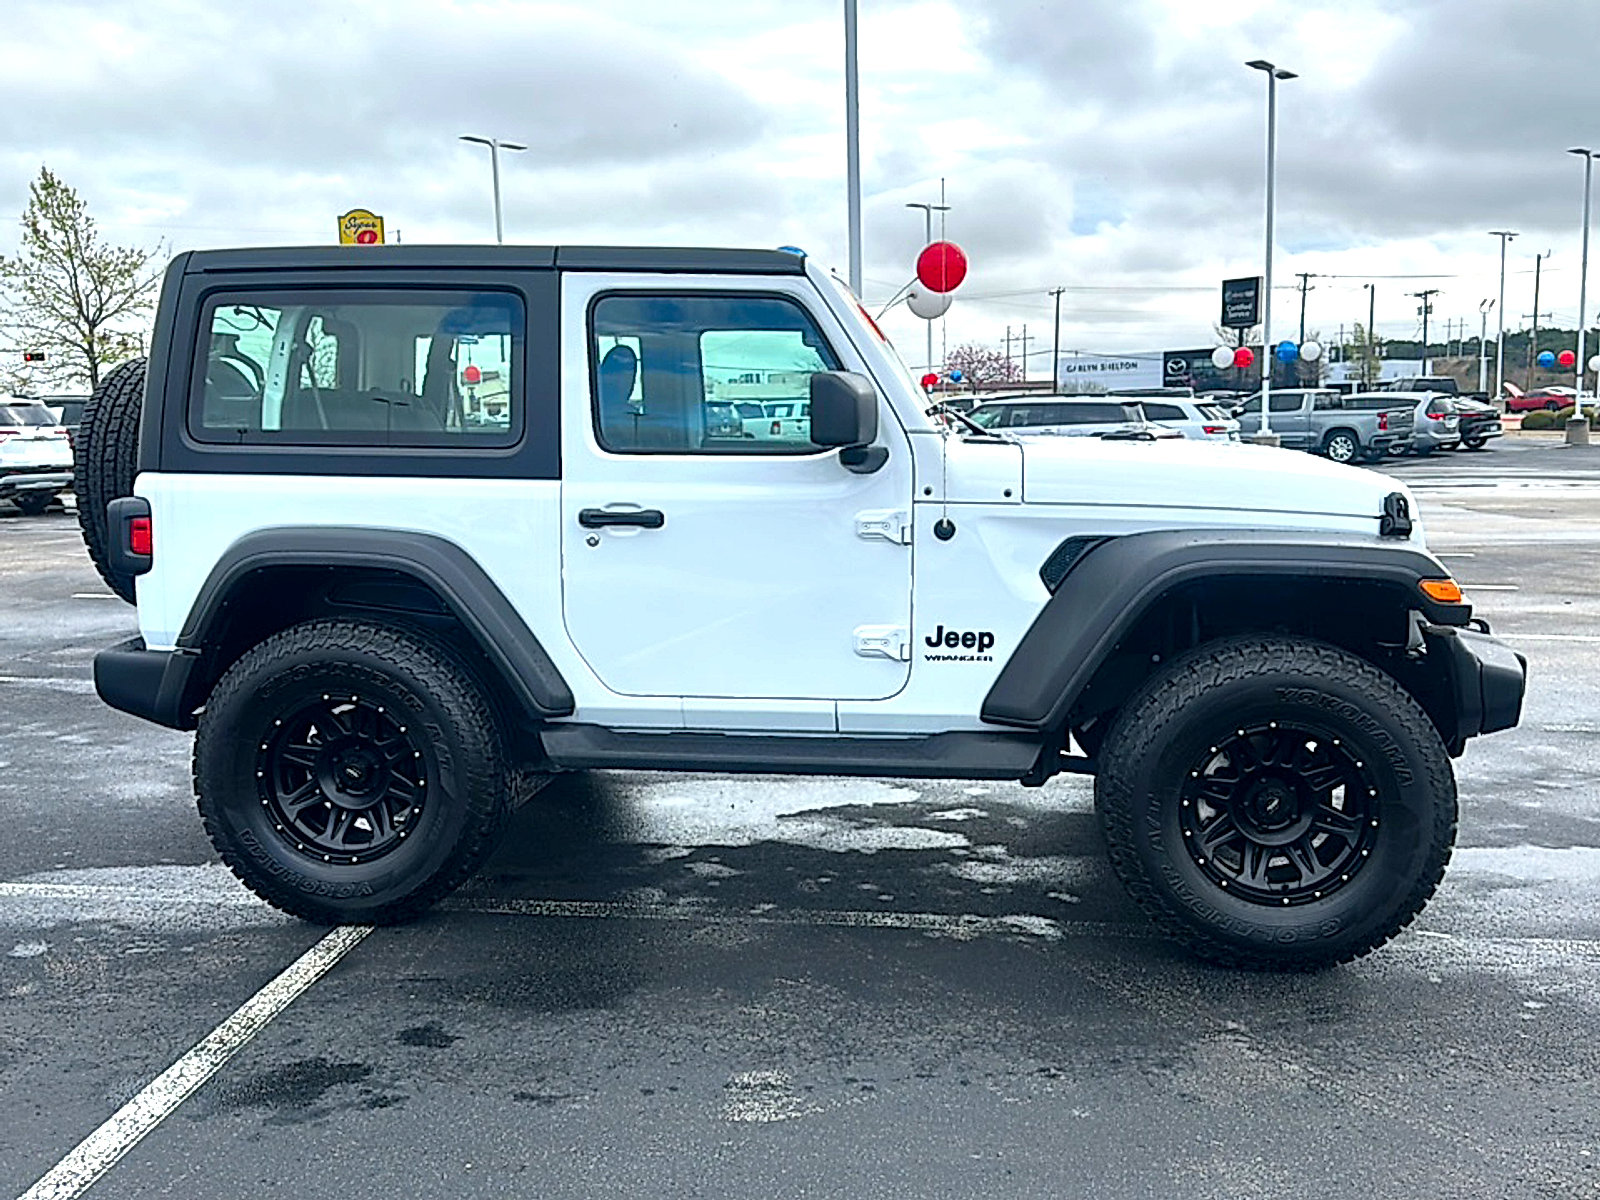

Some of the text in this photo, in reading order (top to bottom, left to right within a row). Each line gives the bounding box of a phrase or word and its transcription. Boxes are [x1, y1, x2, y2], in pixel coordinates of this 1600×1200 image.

[344, 216, 377, 235] Super
[924, 625, 995, 653] Jeep
[924, 654, 994, 662] WRANGLER
[1275, 686, 1416, 788] YOKOHAMA
